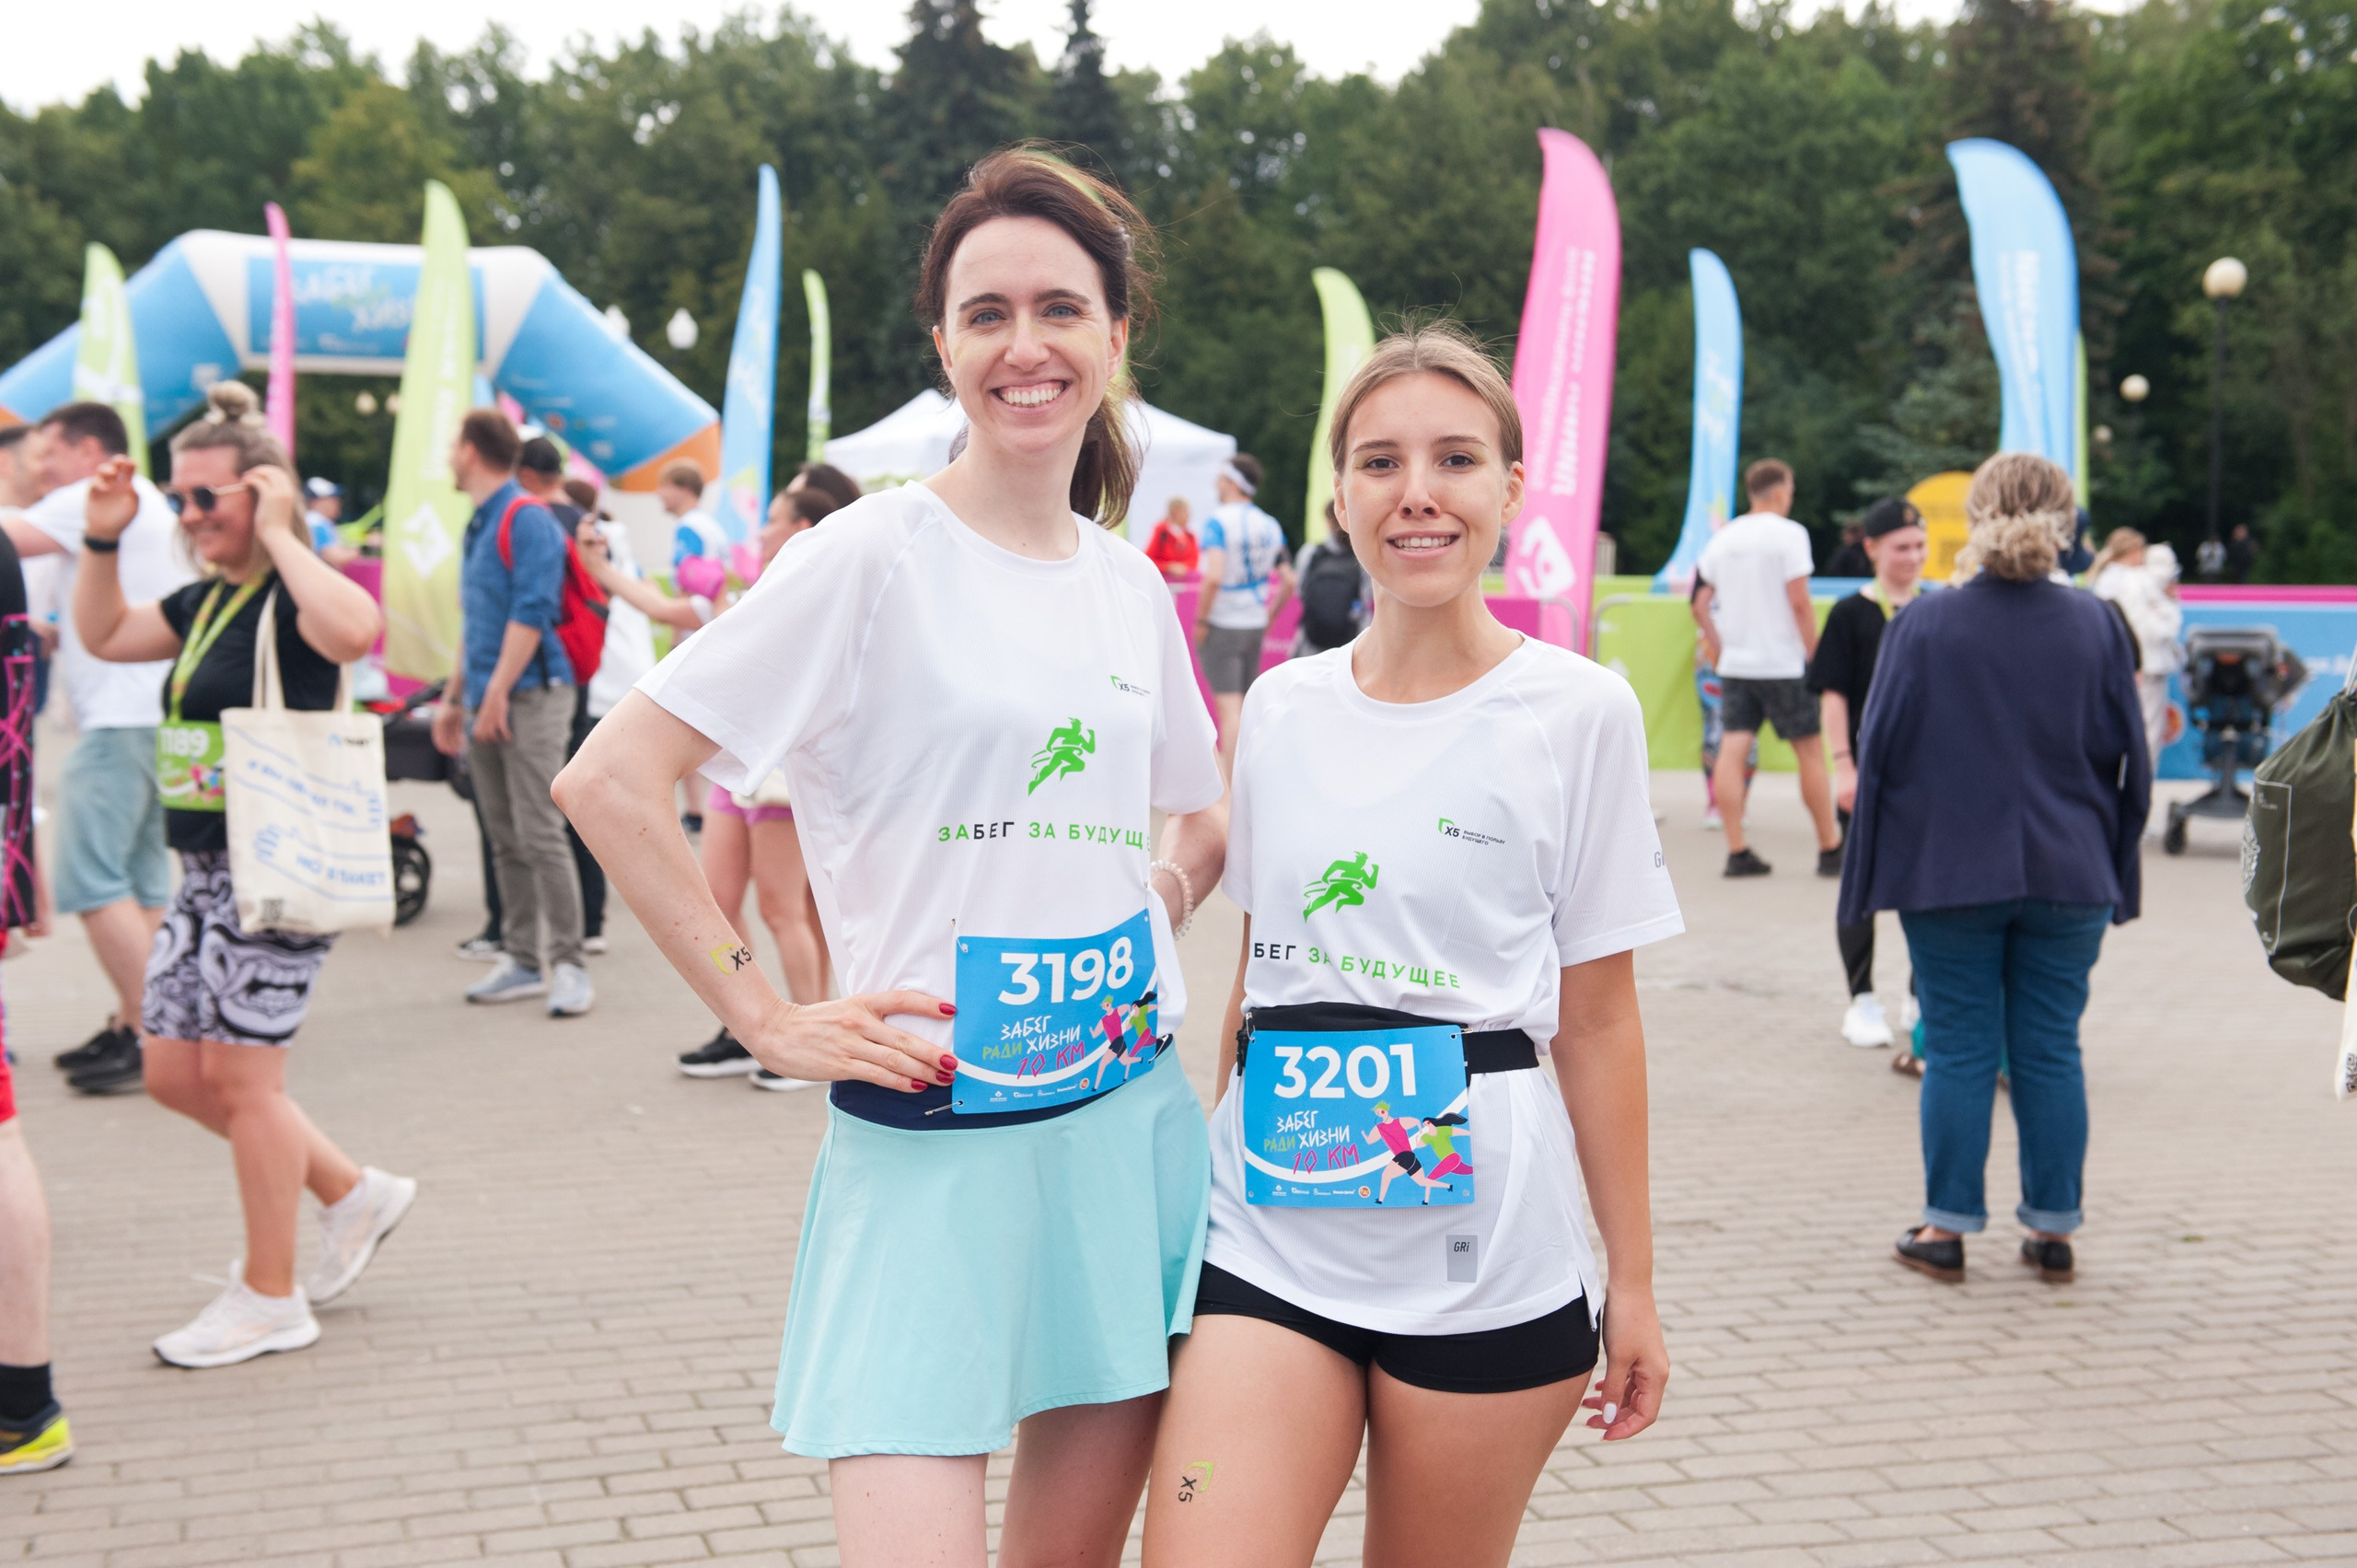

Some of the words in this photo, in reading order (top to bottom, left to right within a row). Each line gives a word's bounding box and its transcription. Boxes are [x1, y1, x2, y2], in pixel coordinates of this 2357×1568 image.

[937, 821, 1015, 842] ЗАБЕГ
[1028, 822, 1056, 839] ЗА
[1069, 824, 1150, 852] БУДУЩ
[998, 936, 1133, 1005] 3198
[1341, 956, 1461, 989] БУДУЩЕЕ
[982, 1041, 1022, 1059] РАДИ
[1027, 1024, 1081, 1054] ЖИЗНИ
[1001, 1016, 1051, 1040] ЗАБЕГ
[1017, 1053, 1045, 1079] 10
[1056, 1040, 1085, 1070] КМ
[1273, 1043, 1416, 1098] 3201
[1277, 1110, 1318, 1133] ЗАБЕГ
[1264, 1136, 1295, 1152] РАДИ
[1297, 1125, 1350, 1149] ЖИЗНИ
[1292, 1150, 1318, 1175] 10
[1329, 1144, 1359, 1169] КМ
